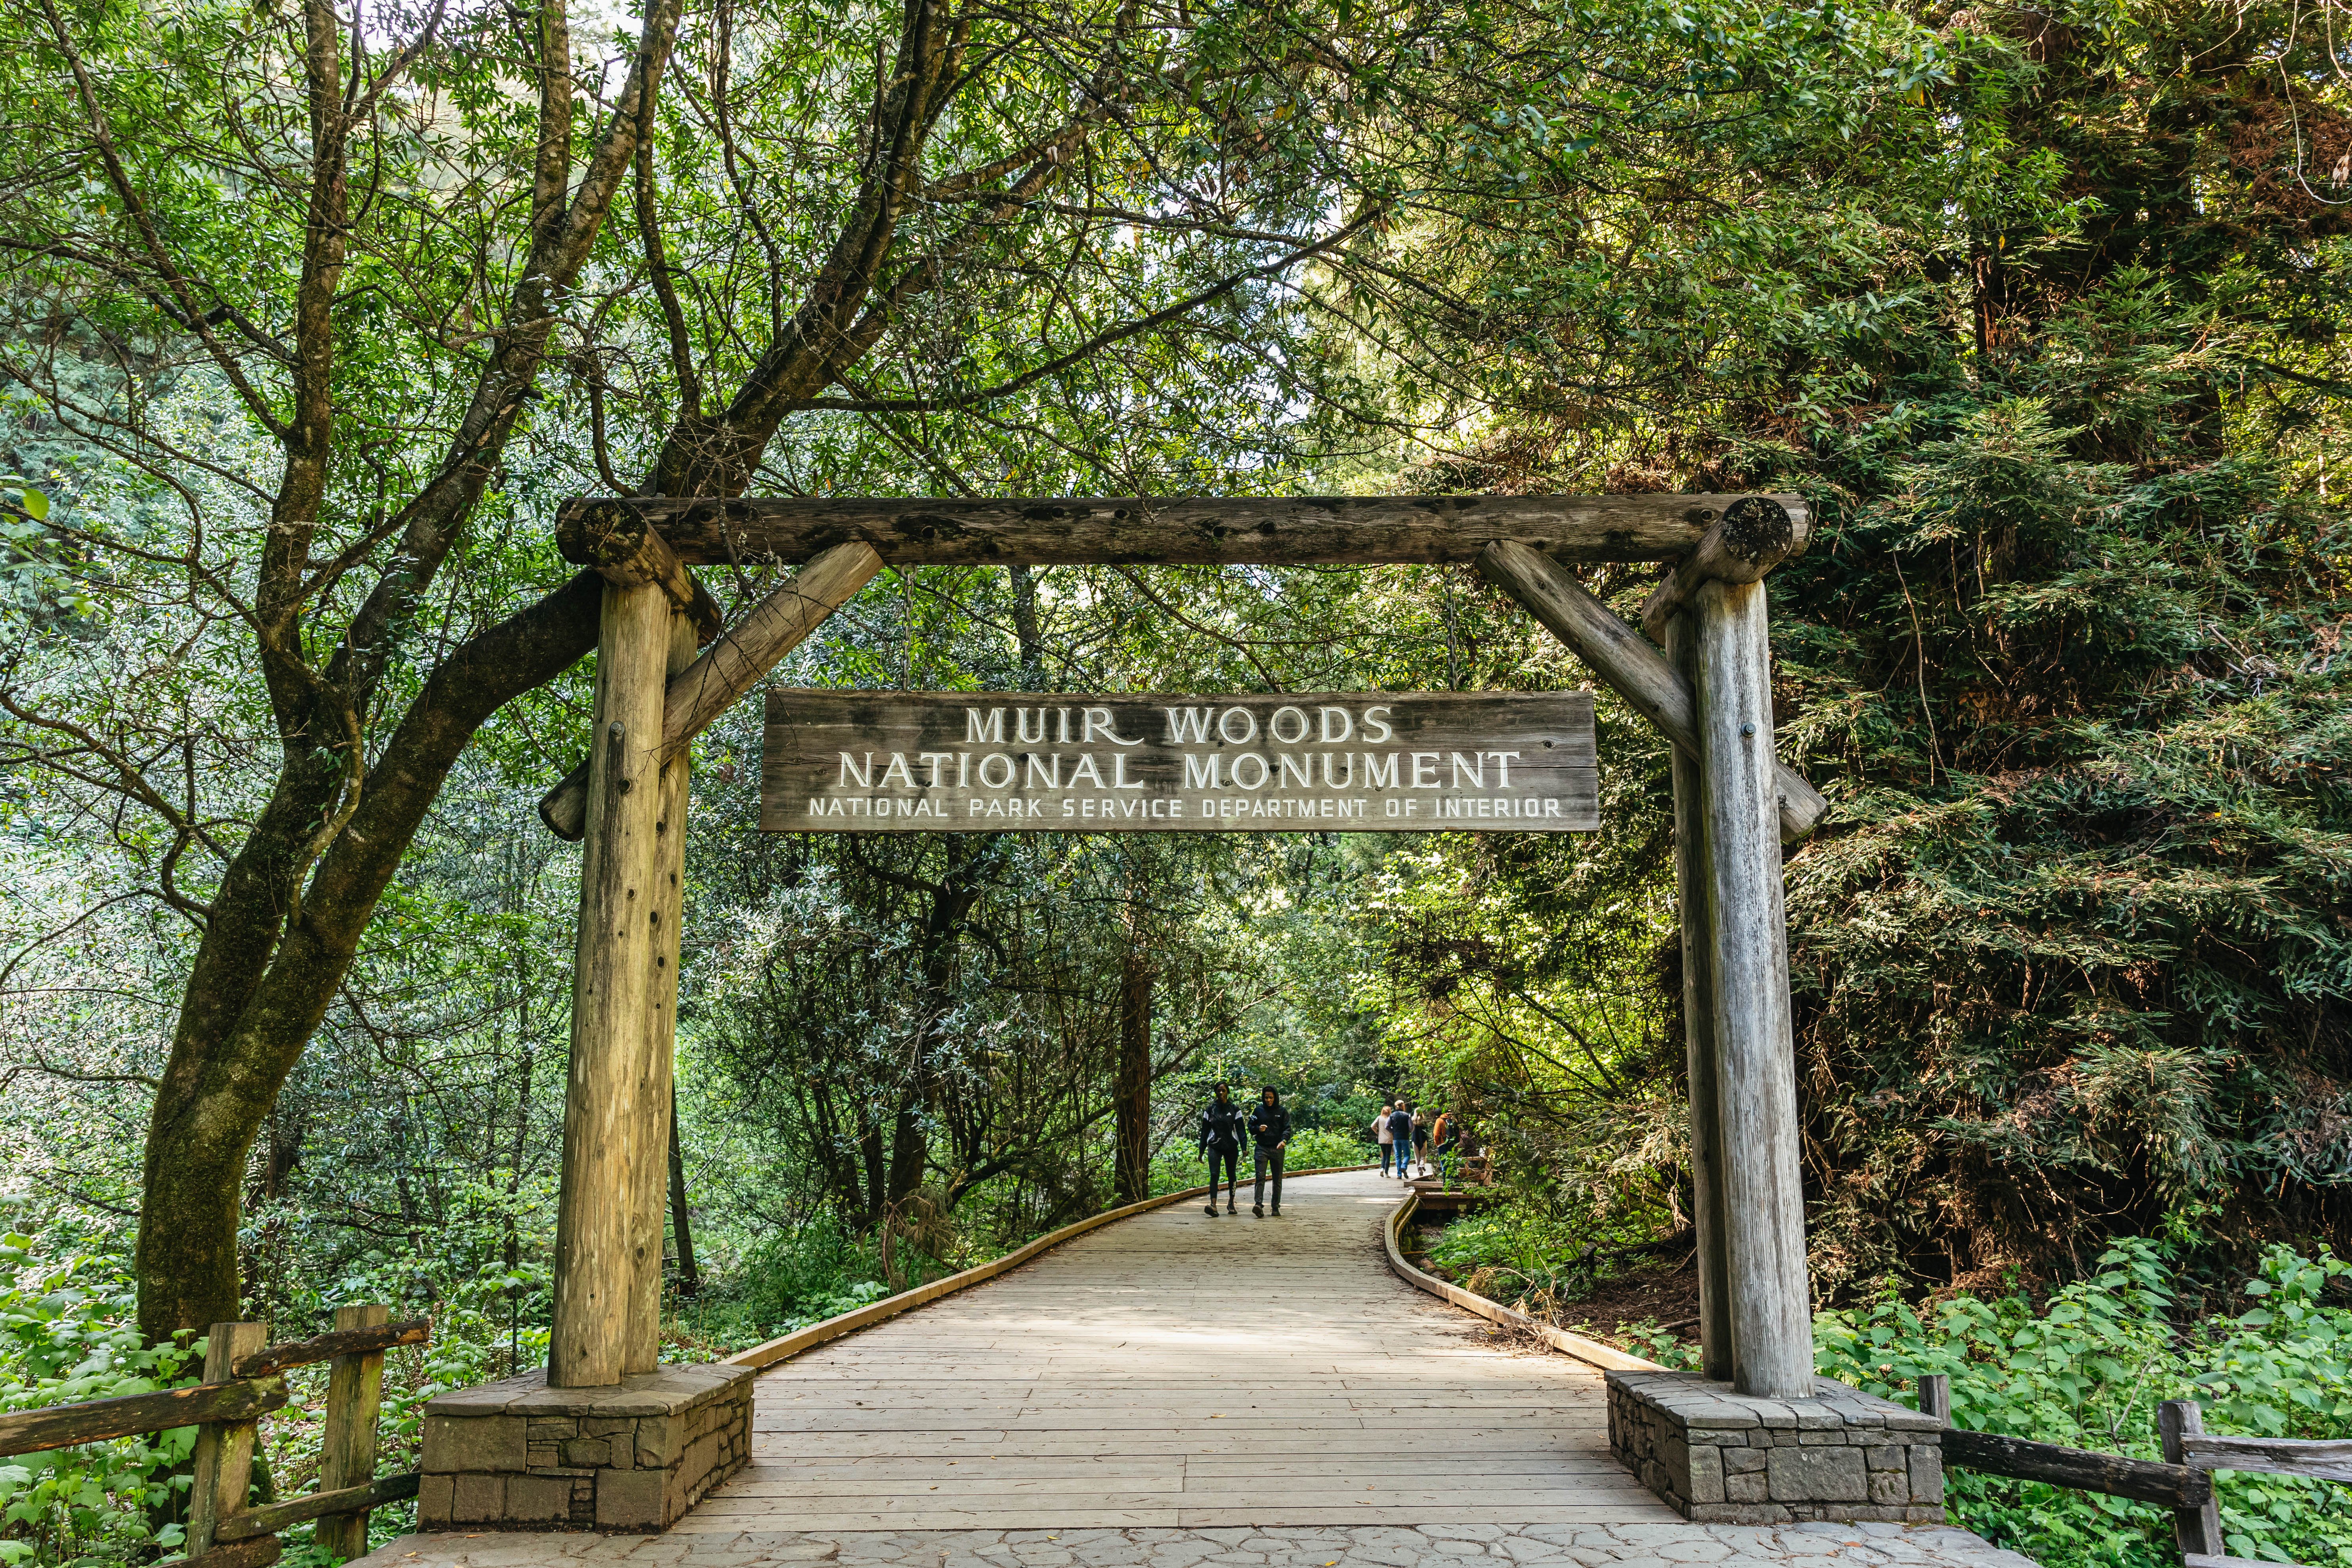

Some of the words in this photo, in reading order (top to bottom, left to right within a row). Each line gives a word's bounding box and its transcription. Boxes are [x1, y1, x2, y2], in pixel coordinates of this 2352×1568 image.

[966, 707, 1144, 745] MUIR
[1165, 705, 1392, 744] WOODS
[838, 752, 1144, 789] NATIONAL
[1184, 751, 1520, 790] MONUMENT
[809, 797, 948, 817] NATIONAL
[969, 798, 1043, 817] PARK
[1062, 798, 1182, 818] SERVICE
[1202, 798, 1368, 818] DEPARTMENT
[1385, 798, 1417, 818] OF
[1435, 798, 1562, 818] INTERIOR
